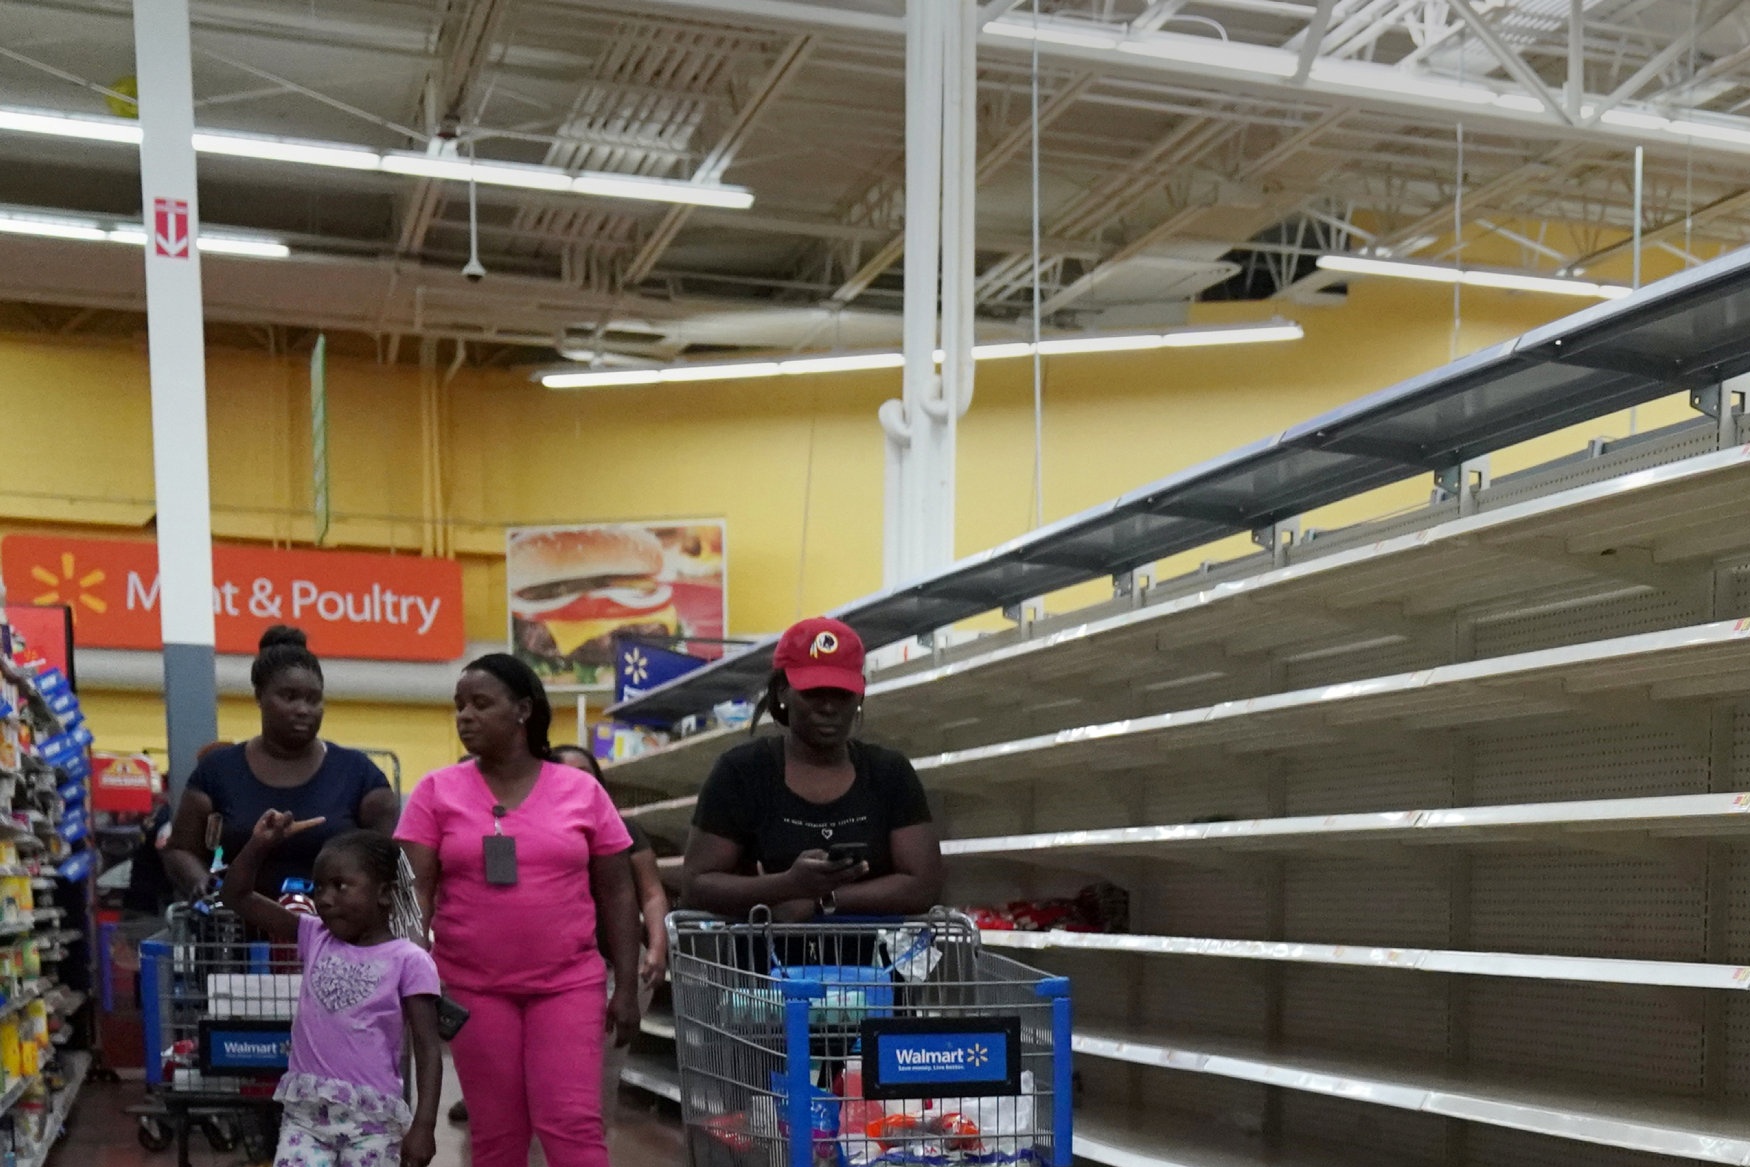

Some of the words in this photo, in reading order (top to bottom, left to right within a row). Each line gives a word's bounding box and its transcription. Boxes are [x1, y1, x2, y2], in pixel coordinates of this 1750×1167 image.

[126, 570, 240, 617] Mt
[249, 577, 282, 618] &
[291, 579, 441, 635] Poultry
[224, 1041, 277, 1054] Walmart
[896, 1048, 964, 1065] Walmart
